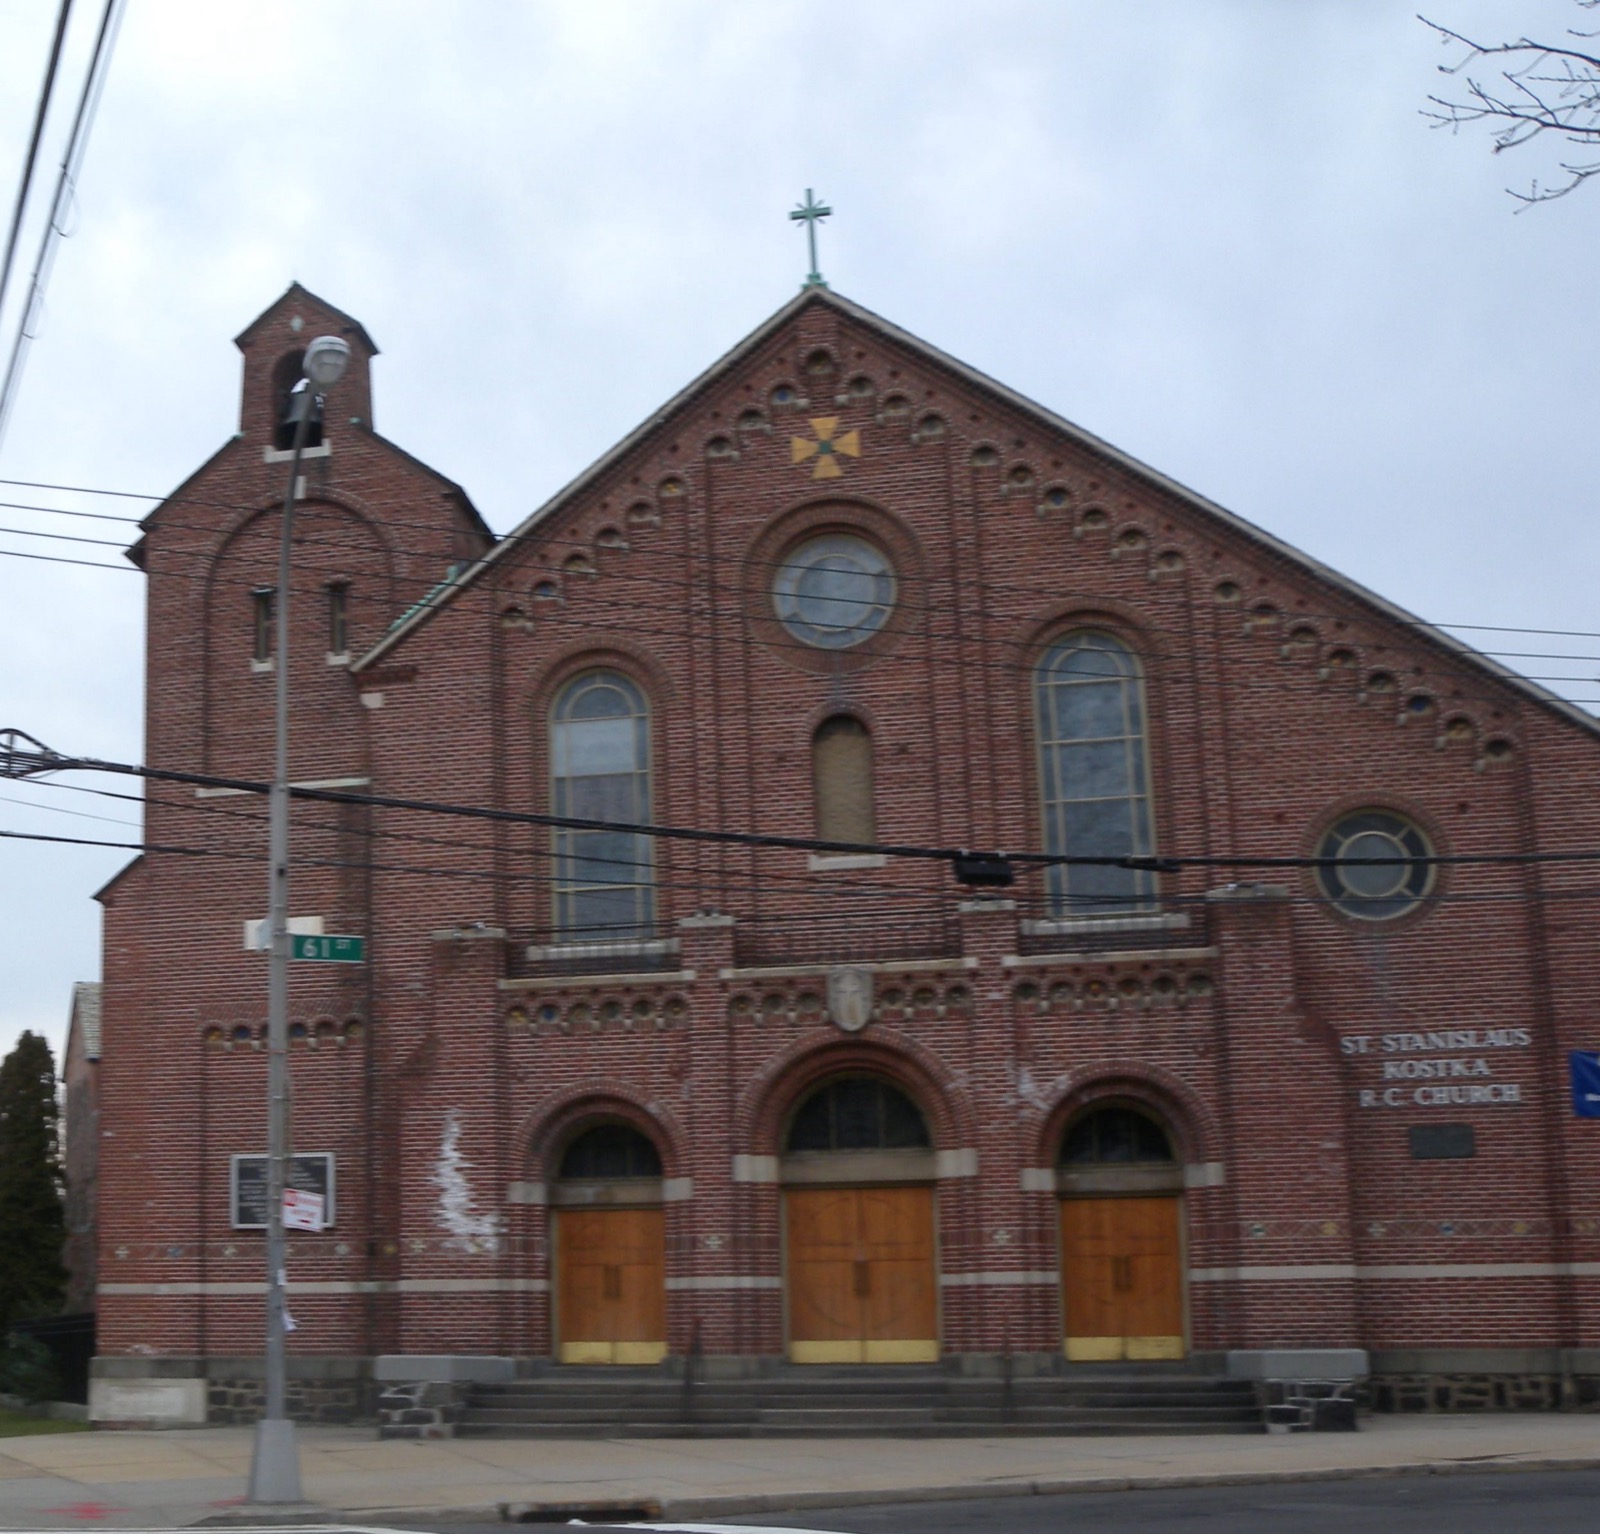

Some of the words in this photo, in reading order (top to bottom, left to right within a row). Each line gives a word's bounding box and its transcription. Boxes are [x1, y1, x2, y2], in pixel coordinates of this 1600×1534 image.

[303, 938, 330, 958] 61
[1382, 1028, 1531, 1052] STANISLAUS
[1383, 1058, 1491, 1079] KOSTKA
[1414, 1084, 1521, 1105] CHURCH
